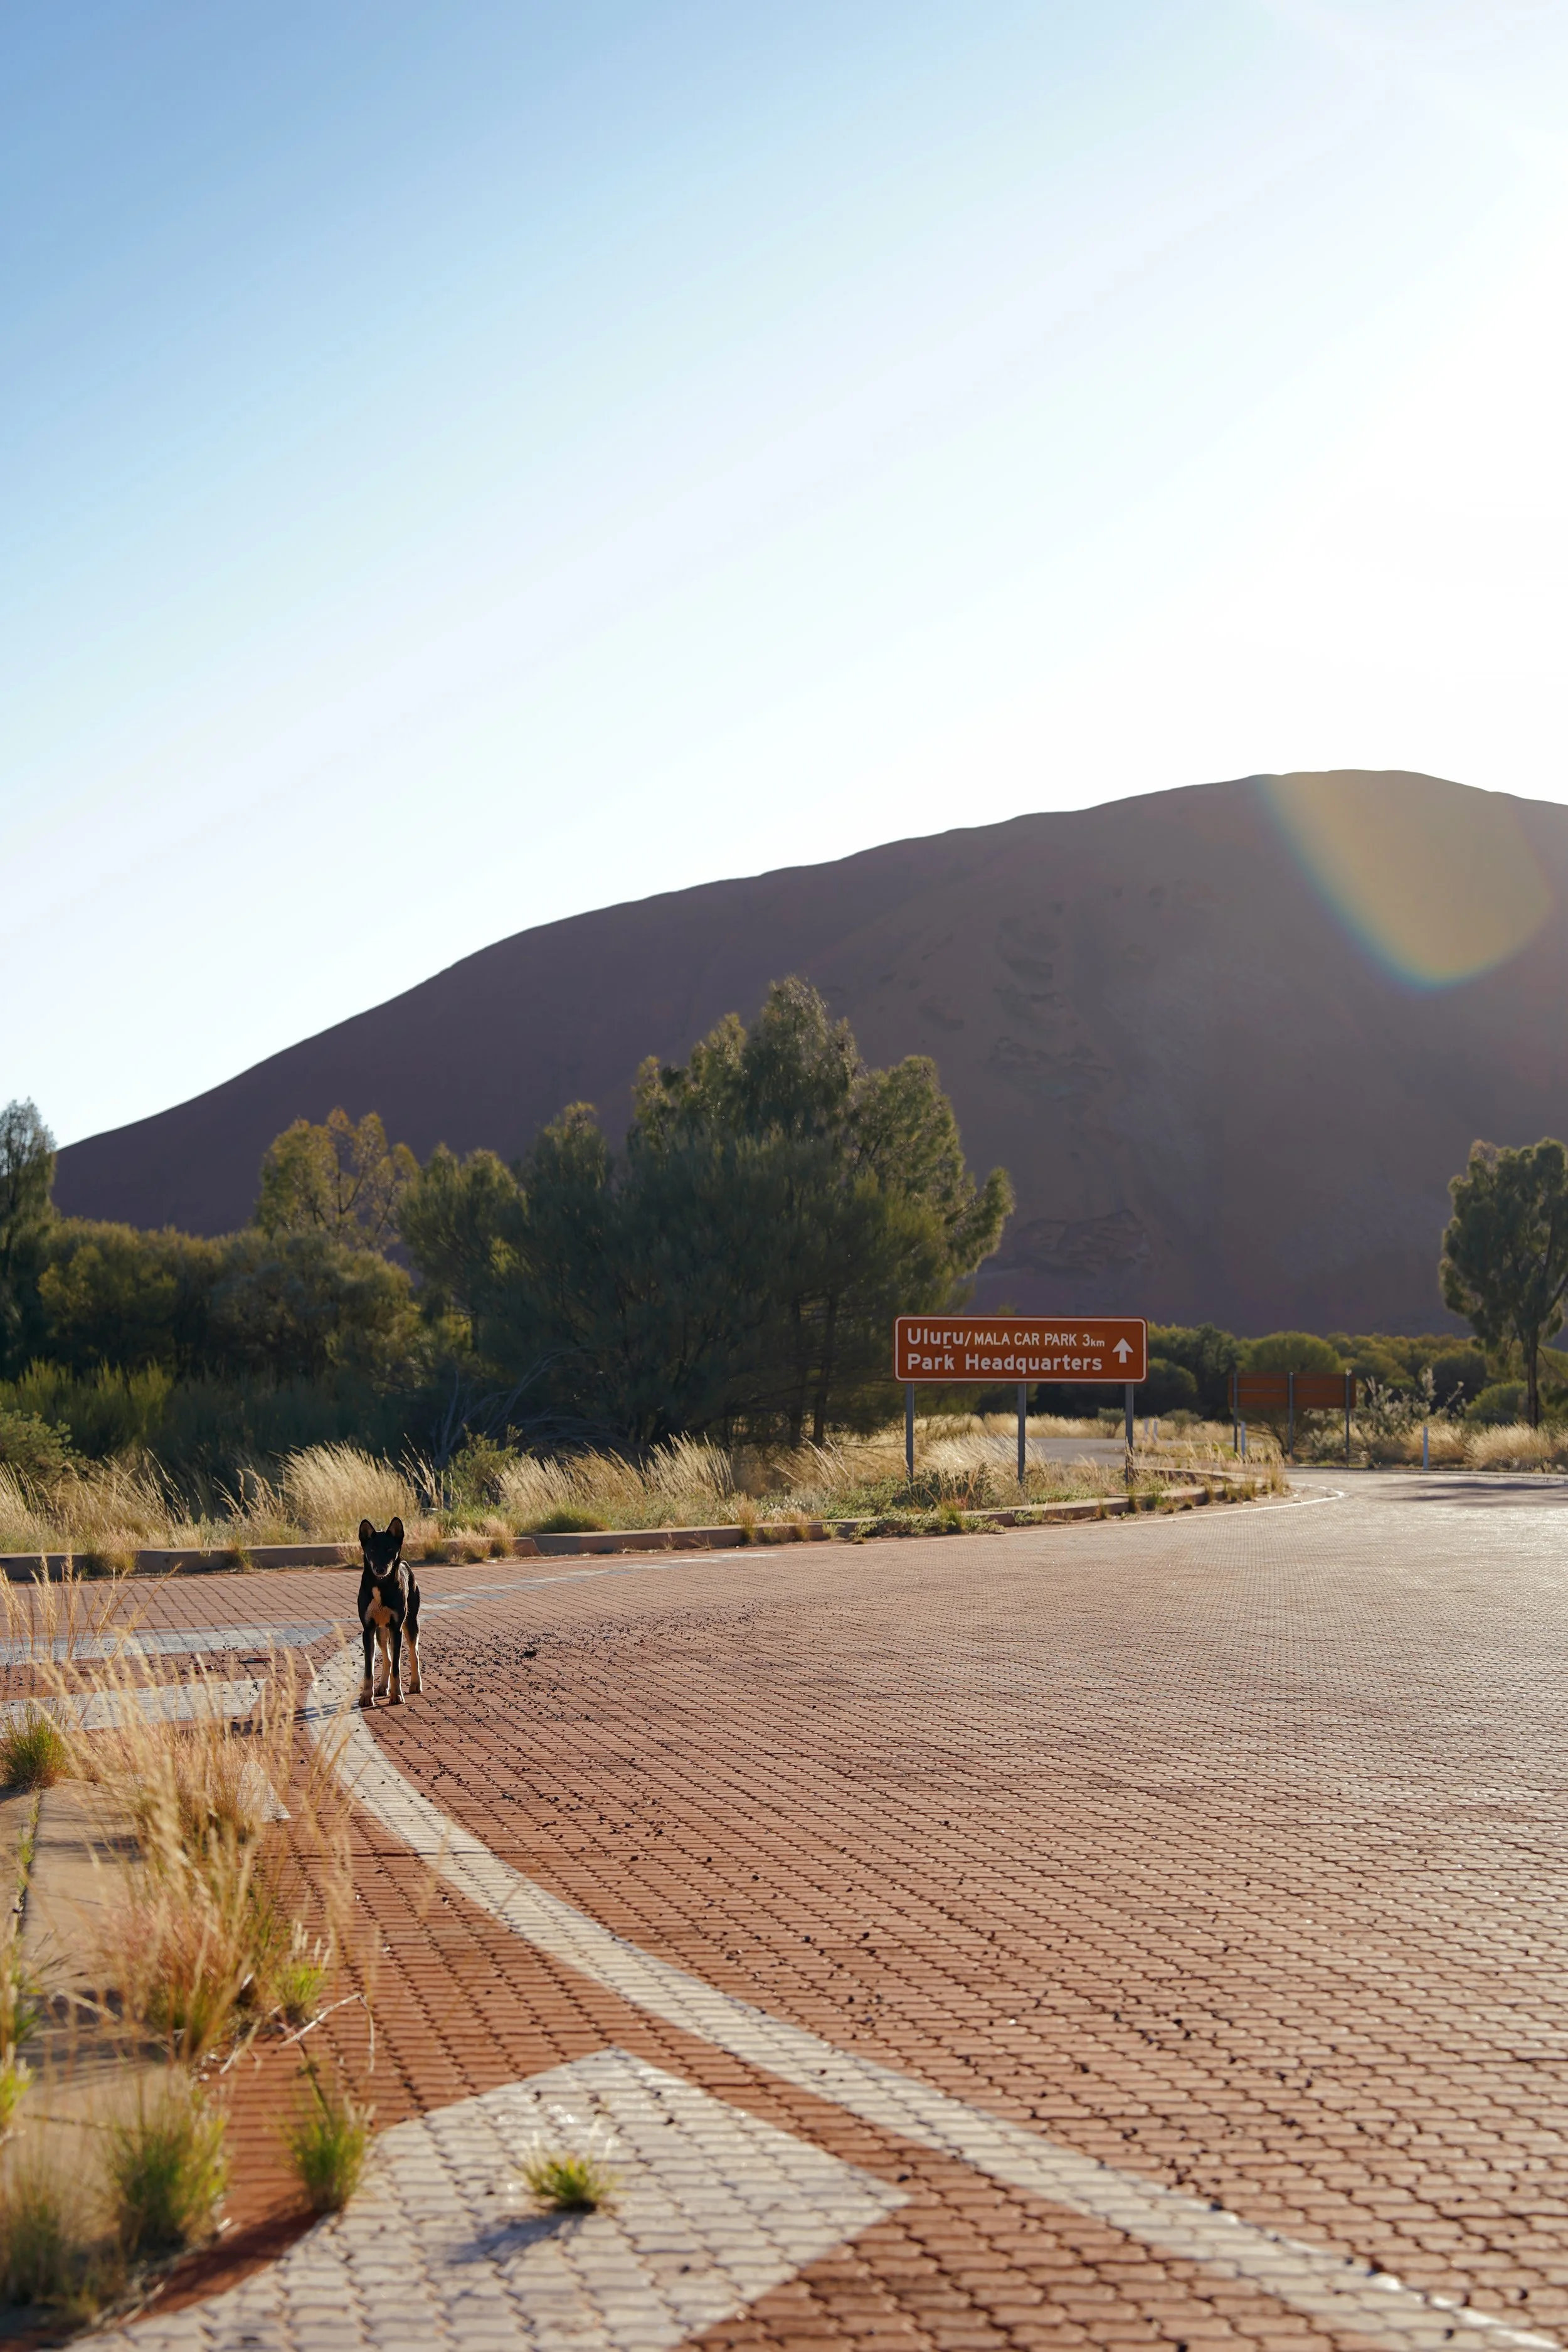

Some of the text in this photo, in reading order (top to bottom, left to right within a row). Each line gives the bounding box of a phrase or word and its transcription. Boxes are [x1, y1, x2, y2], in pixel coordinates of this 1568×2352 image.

[975, 1333, 1010, 1345] MALA
[1014, 1333, 1039, 1346] CAR
[1044, 1334, 1077, 1346] PARK
[1083, 1335, 1104, 1347] 3km
[908, 1353, 1102, 1374] Park Headquarters
